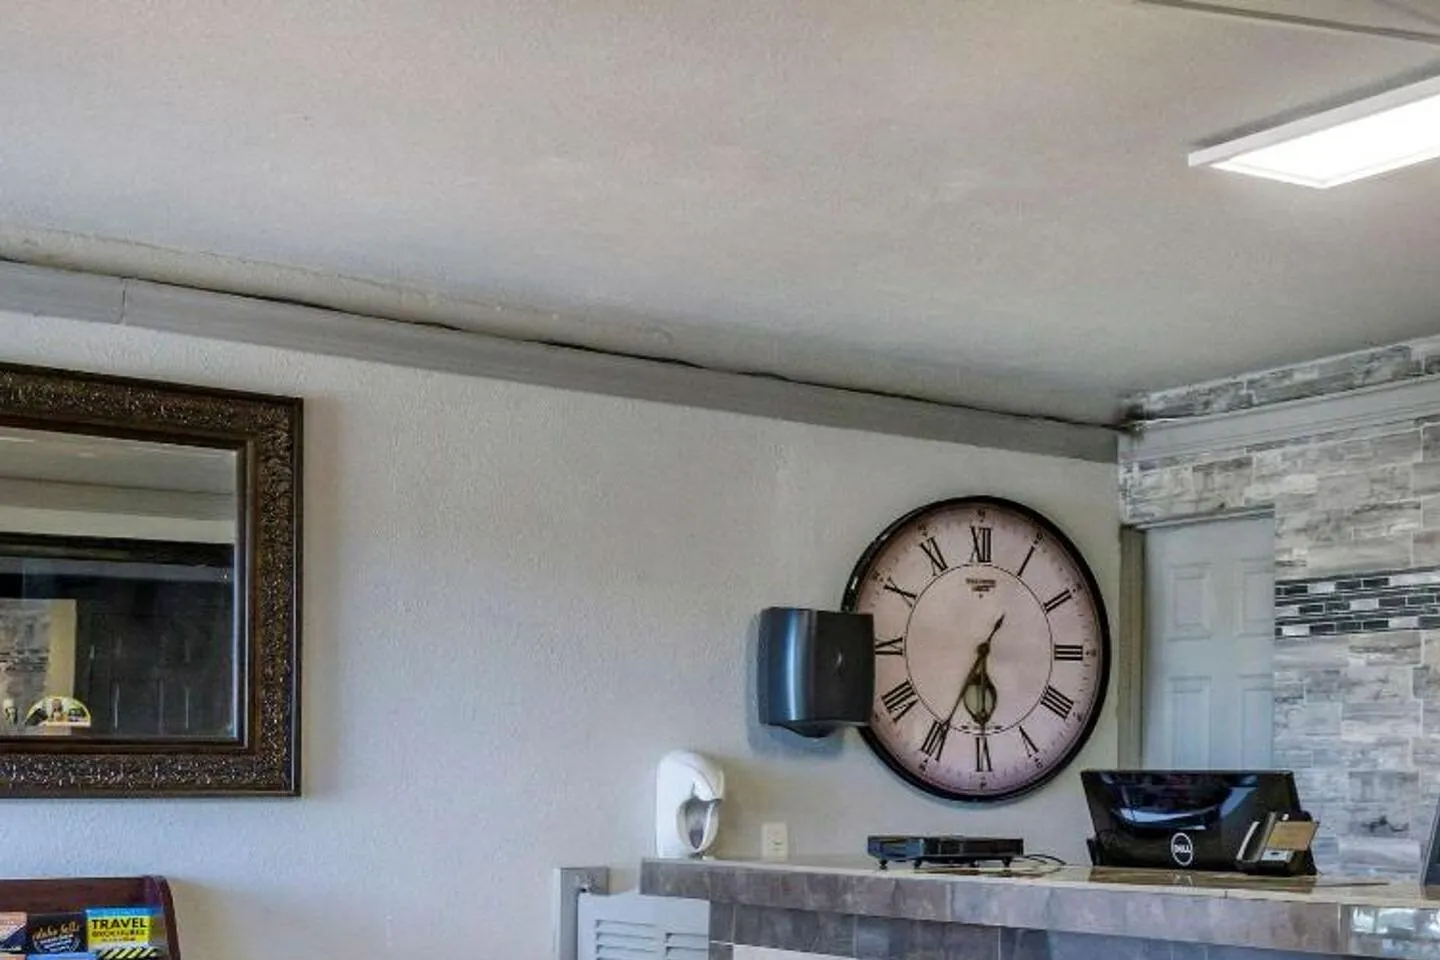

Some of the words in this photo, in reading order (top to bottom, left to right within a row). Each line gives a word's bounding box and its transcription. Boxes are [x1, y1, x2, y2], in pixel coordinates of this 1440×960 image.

[918, 535, 949, 577] XI
[969, 525, 993, 563] XII
[883, 576, 918, 608] X
[1042, 587, 1073, 614] II
[1053, 643, 1084, 662] III
[880, 679, 919, 724] VIII
[974, 735, 994, 773] VI
[1174, 844, 1191, 853] DELL
[91, 917, 148, 930] TRAVEL
